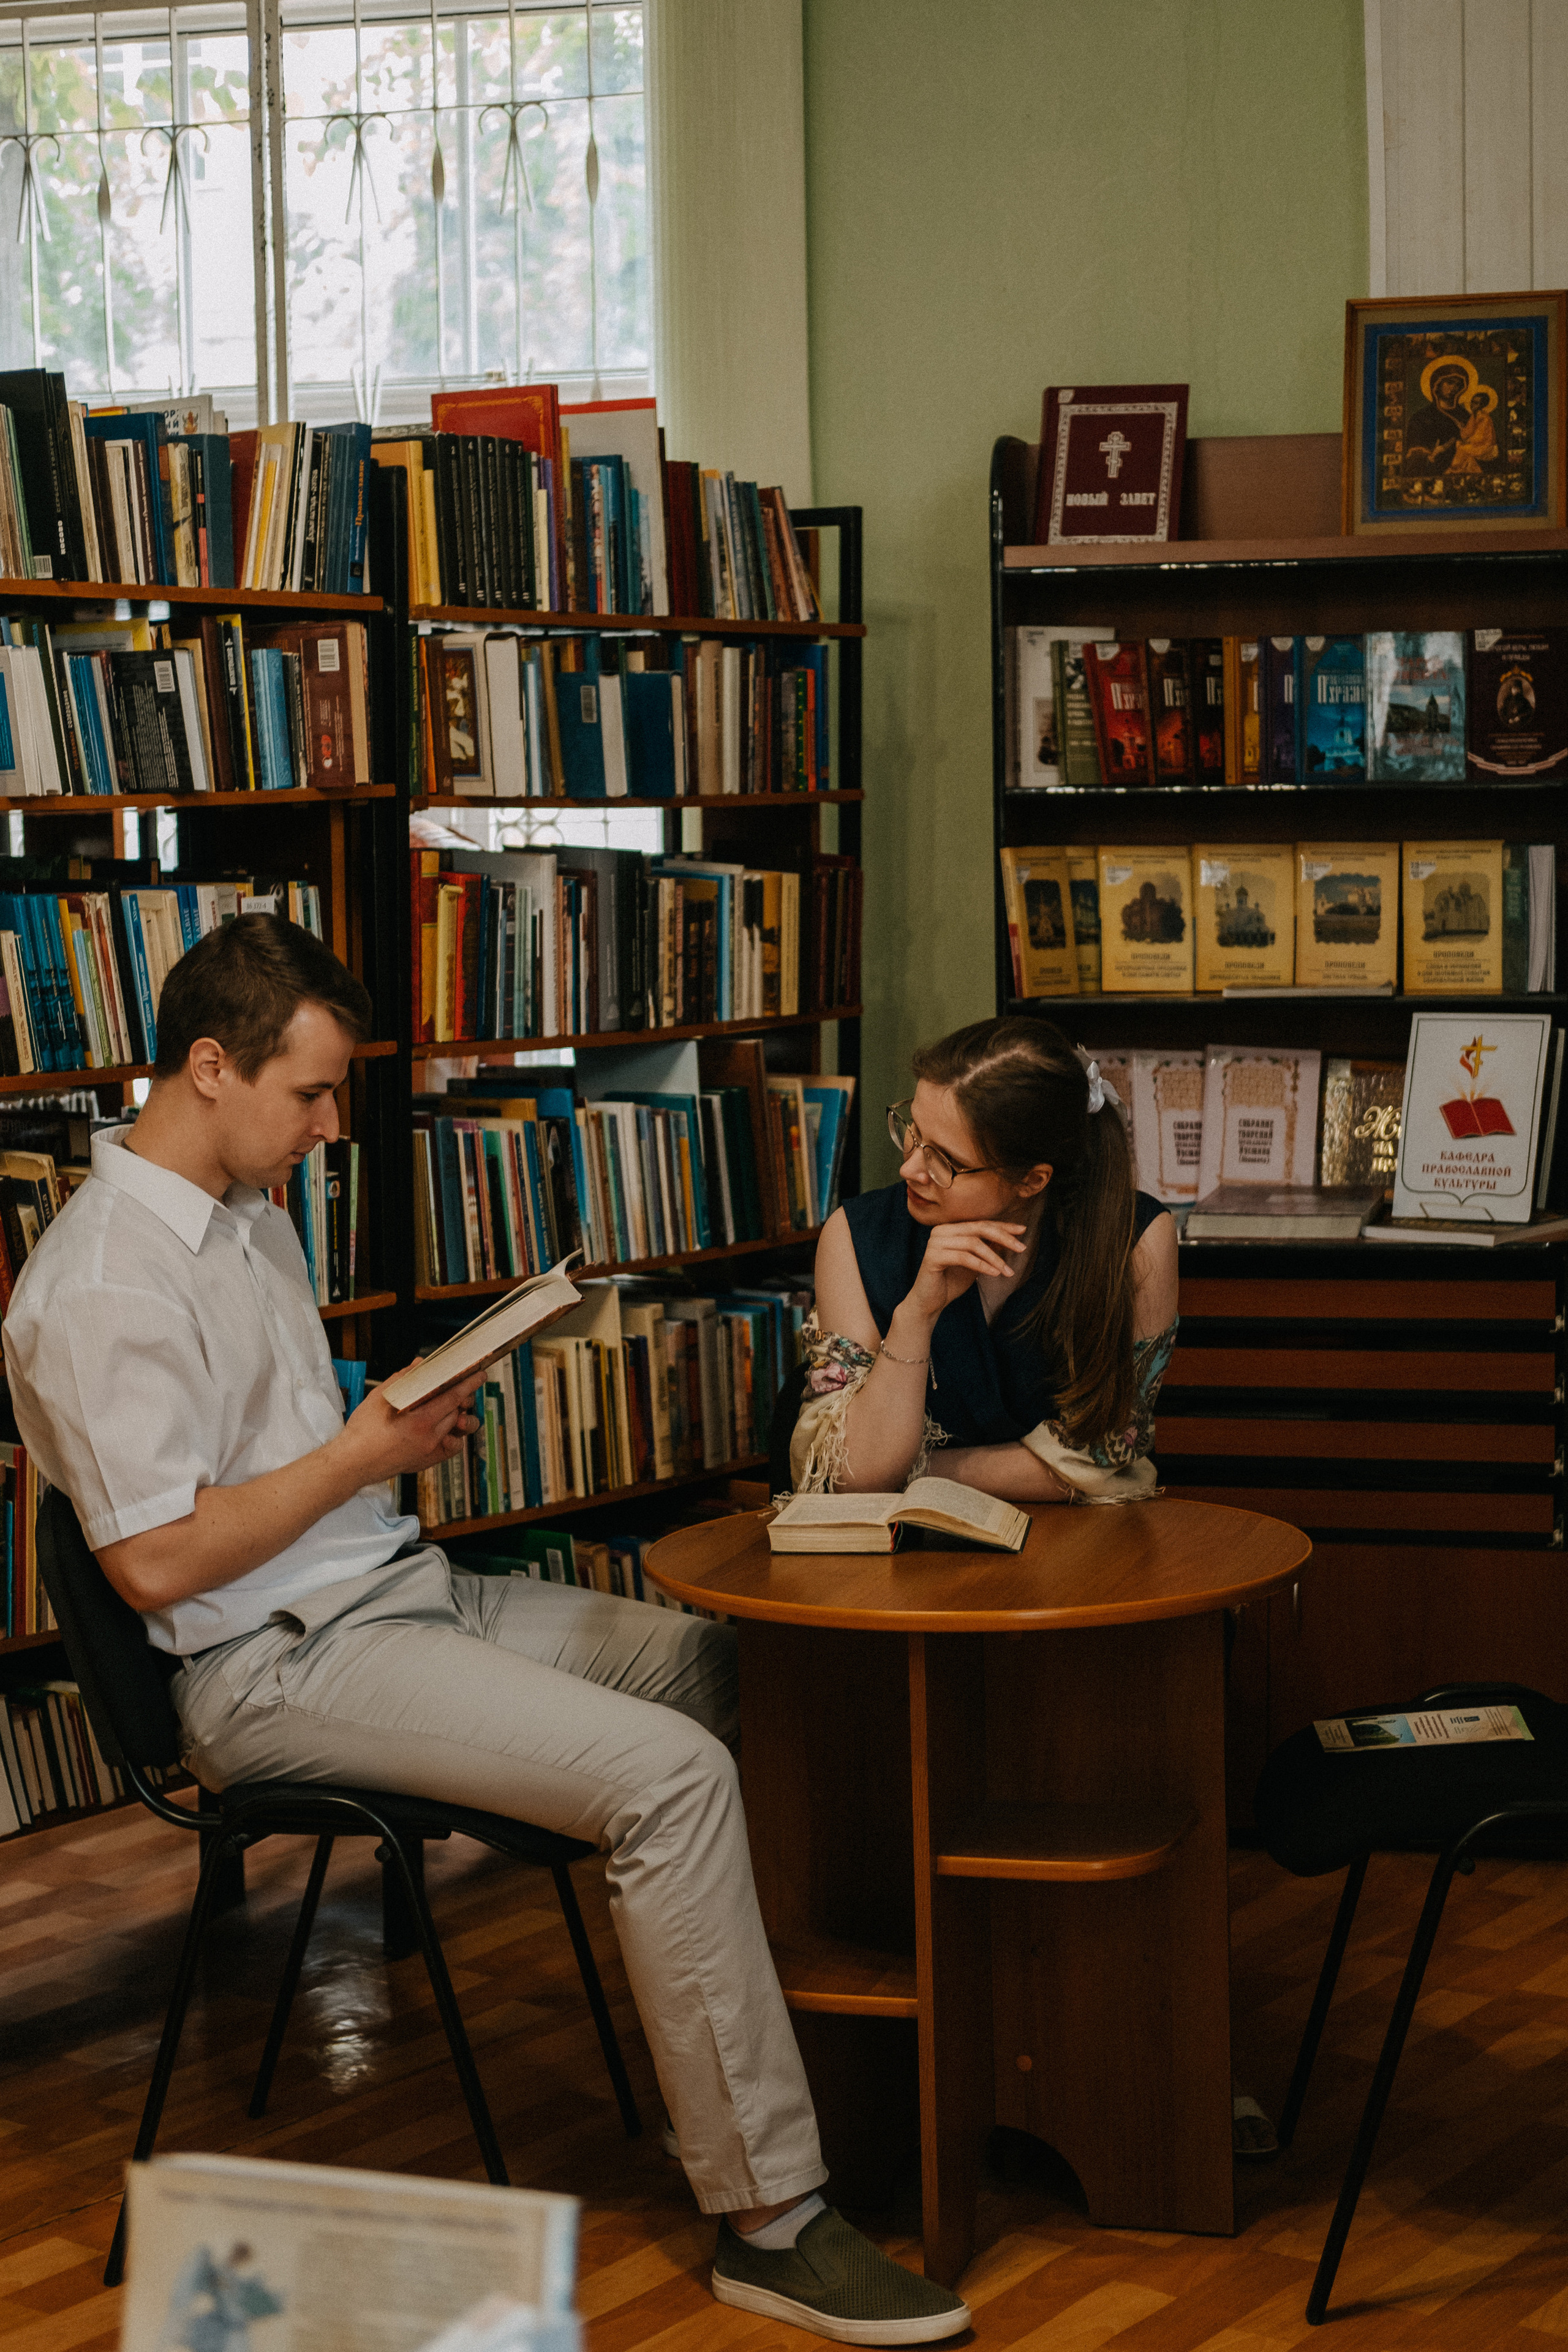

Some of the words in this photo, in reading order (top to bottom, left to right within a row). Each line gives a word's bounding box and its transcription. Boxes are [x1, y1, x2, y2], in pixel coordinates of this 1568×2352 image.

[355, 459, 364, 526] Православие
[1066, 491, 1109, 507] НОВЫЙ
[1120, 492, 1157, 506] ЗАВЕТ
[9, 941, 19, 983] ЗАТВОРНИК
[15, 986, 24, 1017] ФЕОФАН
[20, 1020, 30, 1060] СВЯТИТЕЛЬ
[1440, 1150, 1495, 1163] КАФЕДРА
[1421, 1164, 1512, 1178] ПРАВОСЛАВНОЙ
[1433, 1177, 1496, 1191] КУЛЬТУРЫ
